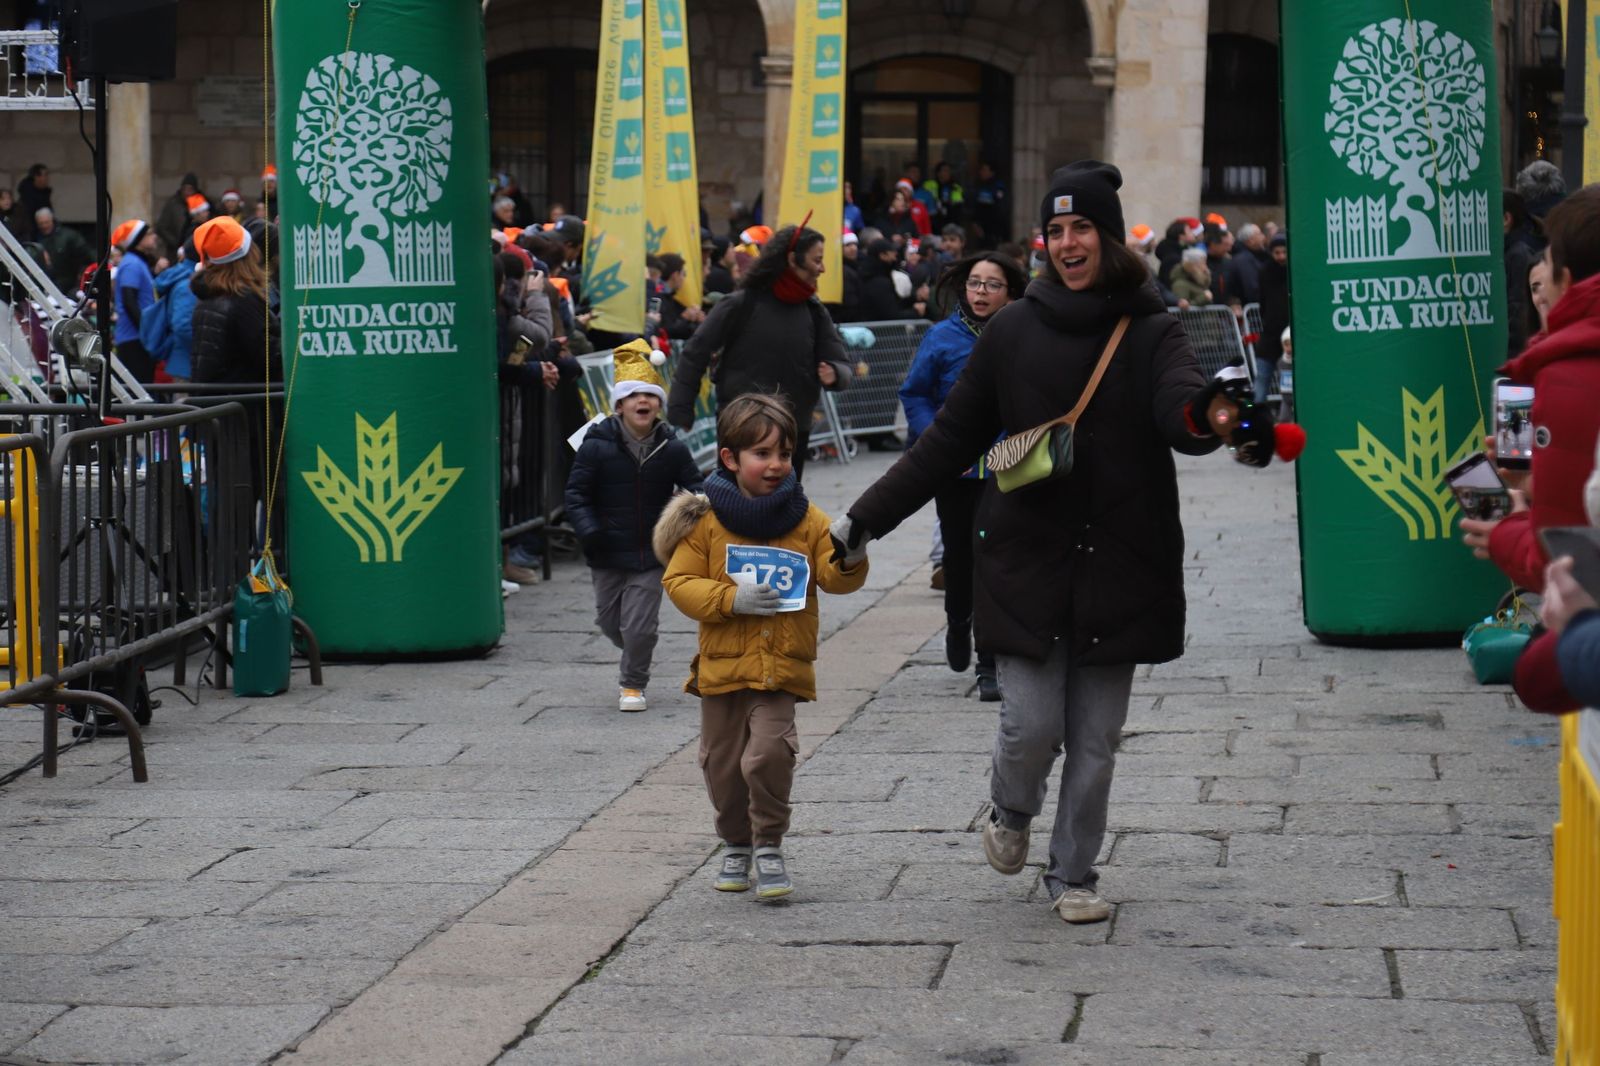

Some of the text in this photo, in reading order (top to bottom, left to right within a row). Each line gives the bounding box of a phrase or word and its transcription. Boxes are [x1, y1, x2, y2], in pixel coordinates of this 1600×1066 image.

[1331, 272, 1492, 304] FUNDACION
[297, 302, 456, 329] FUNDACION
[1332, 300, 1494, 333] CAJA RURAL
[299, 329, 458, 358] CAJA RURAL
